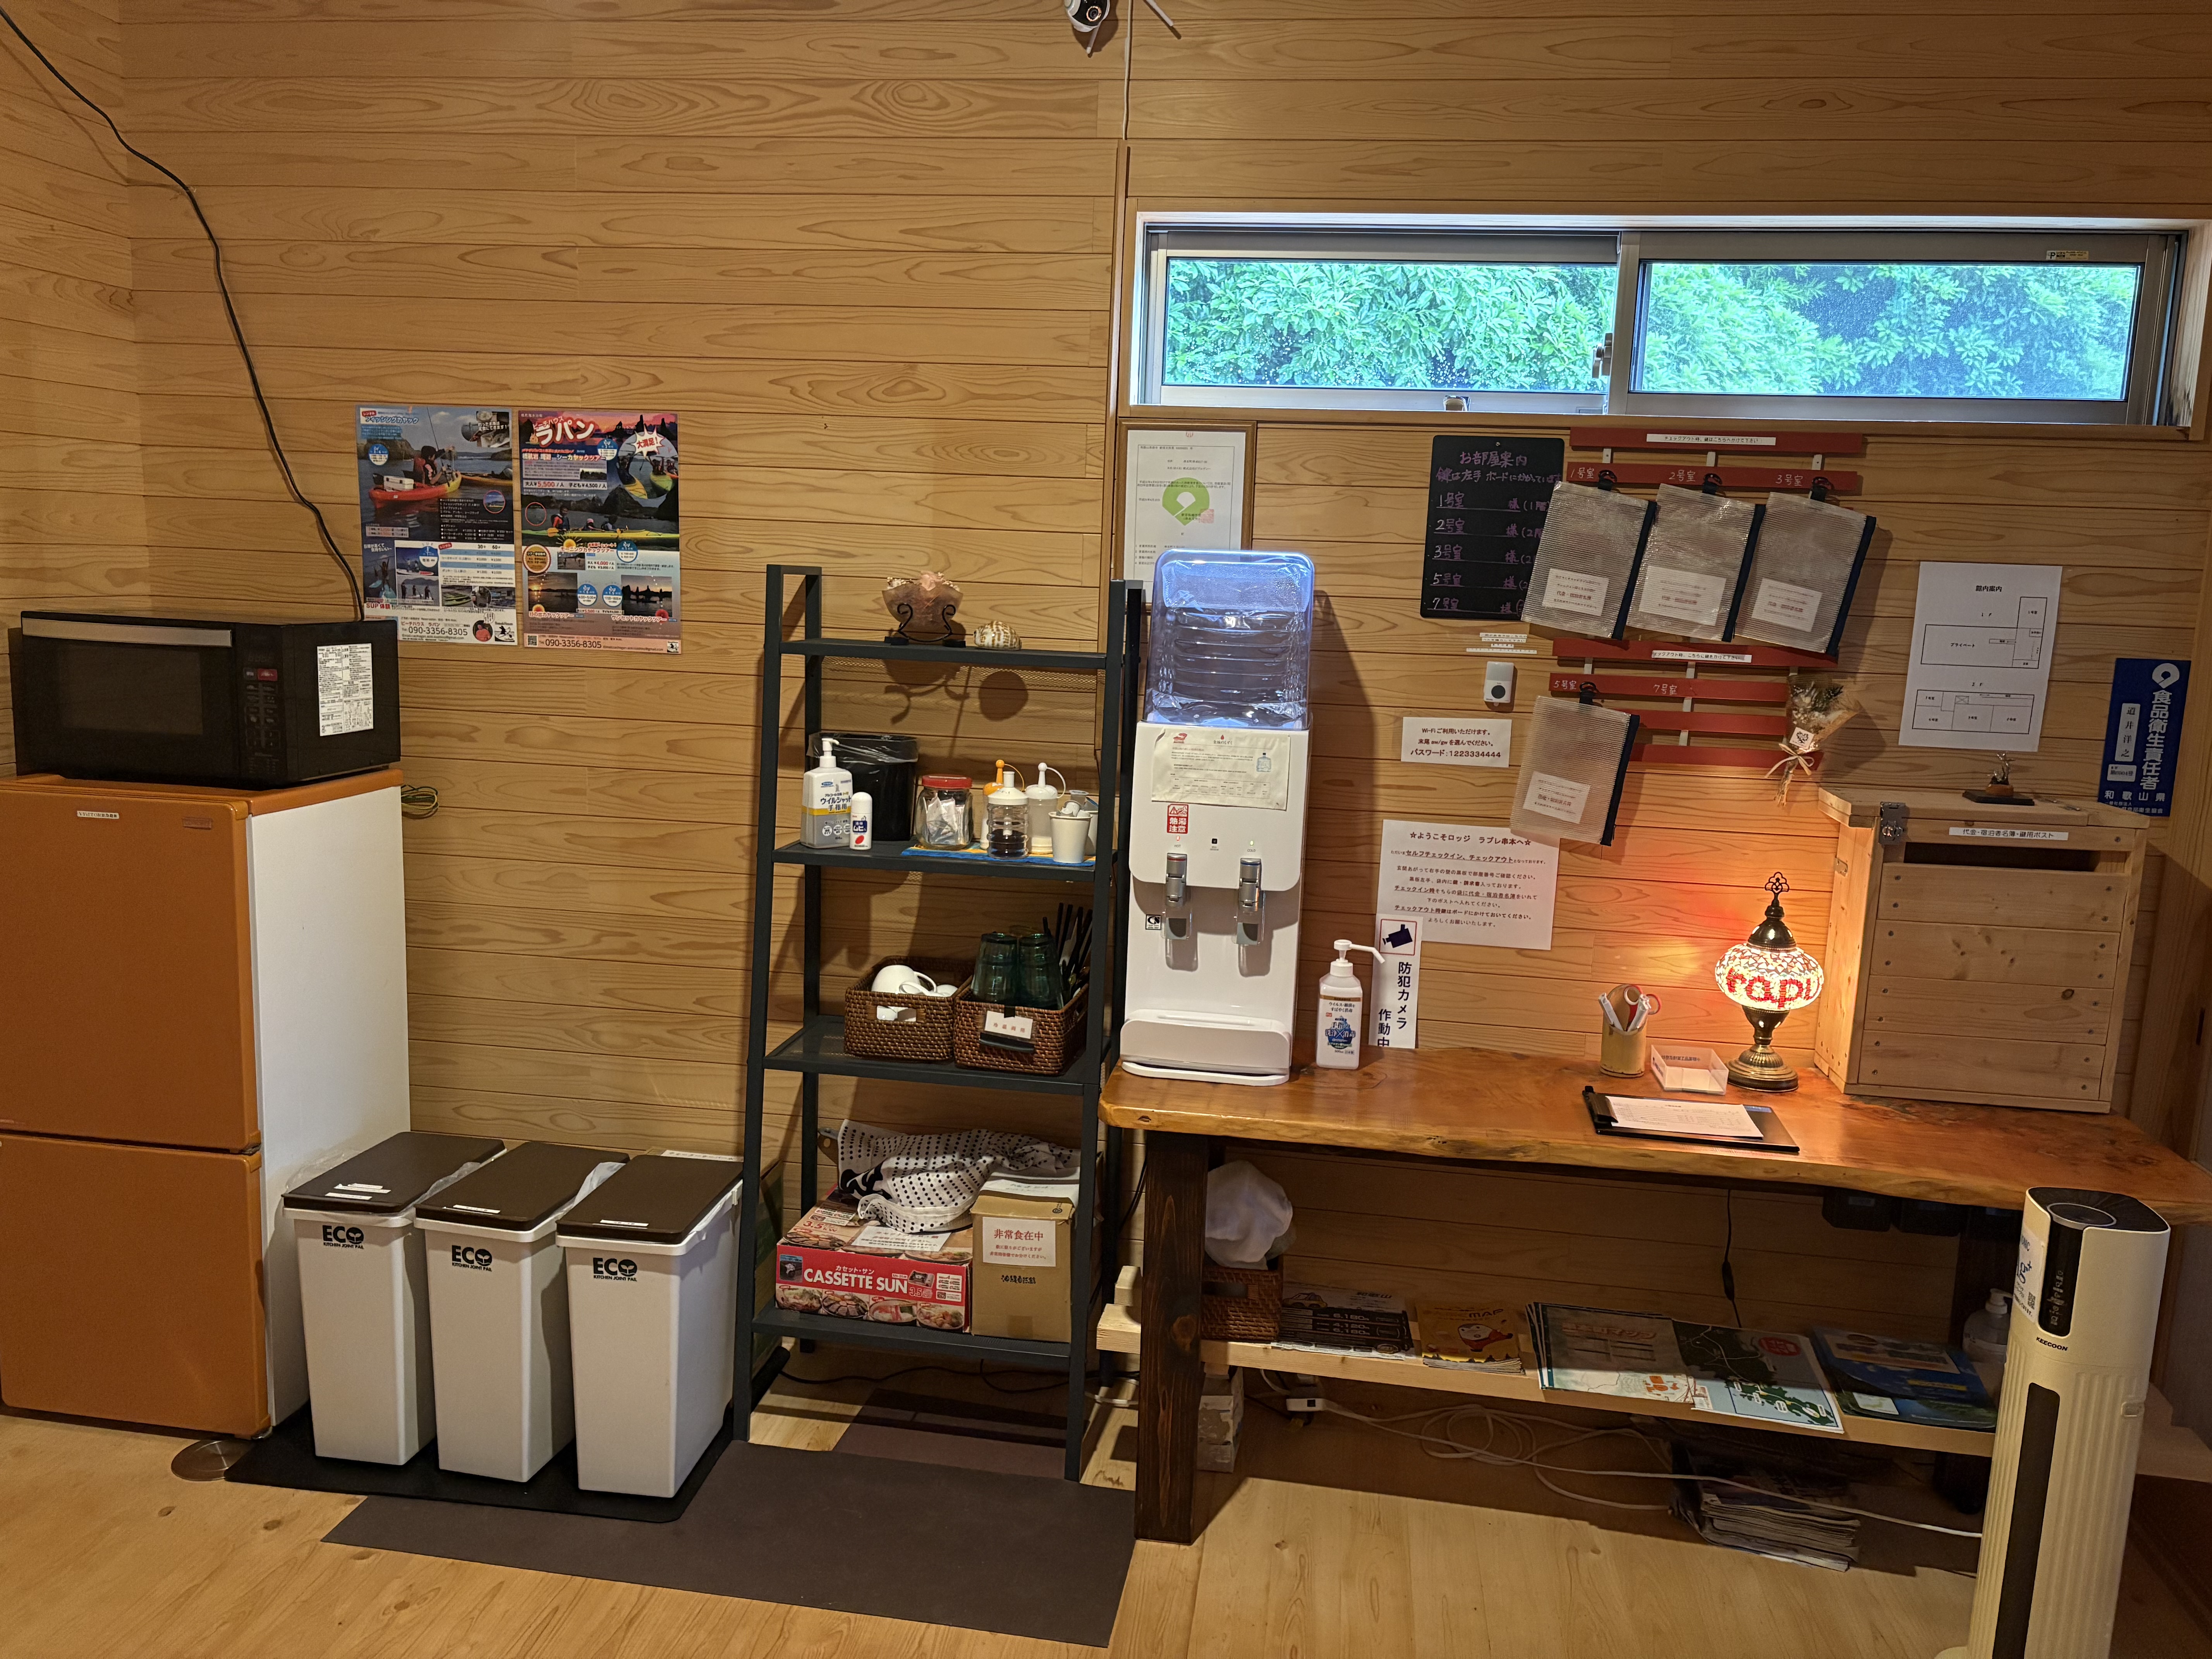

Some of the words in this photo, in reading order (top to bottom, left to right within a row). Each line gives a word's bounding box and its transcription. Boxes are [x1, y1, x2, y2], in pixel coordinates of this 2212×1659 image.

[533, 417, 564, 429] ビーチハウス
[536, 420, 594, 445] ラパン
[1460, 451, 1527, 468] お部屋案内
[1571, 467, 1594, 479] 1号室
[1668, 469, 1696, 482] 2号室
[1776, 475, 1803, 486] 3号室
[1439, 491, 1464, 508] 1号室
[1437, 518, 1465, 534] 2号室
[1506, 524, 1518, 537] 様
[1434, 544, 1463, 560] 3号室
[1505, 551, 1519, 563] 様
[1432, 573, 1462, 586] 5号室
[1432, 598, 1460, 610] 7号室
[409, 627, 468, 635] 090-3356-8305
[545, 639, 601, 648] 090-3356-8305
[1553, 680, 1576, 690] 5号室
[1653, 684, 1677, 695] 7号室
[2121, 707, 2136, 757] 道井洋之
[2140, 690, 2172, 790] 食品衛生責任者
[821, 796, 852, 805] ウイルシャット
[2105, 790, 2166, 802] 和歌山県
[1428, 918, 1496, 927] よろしくお願いいたします。
[1397, 962, 1412, 1029] 防犯カメラ
[1377, 1008, 1392, 1047] 作動中
[803, 1221, 822, 1229] 3.5
[322, 1225, 364, 1244] ECO
[994, 1229, 1043, 1241] 非常食在中
[452, 1245, 492, 1266] ECO
[593, 1257, 637, 1277] ECO
[836, 1265, 874, 1274] カセット・サン
[804, 1268, 873, 1289] CASSETTE
[876, 1277, 908, 1293] SUN
[909, 1286, 922, 1297] 3.5
[2036, 1336, 2068, 1351] KEECOON
